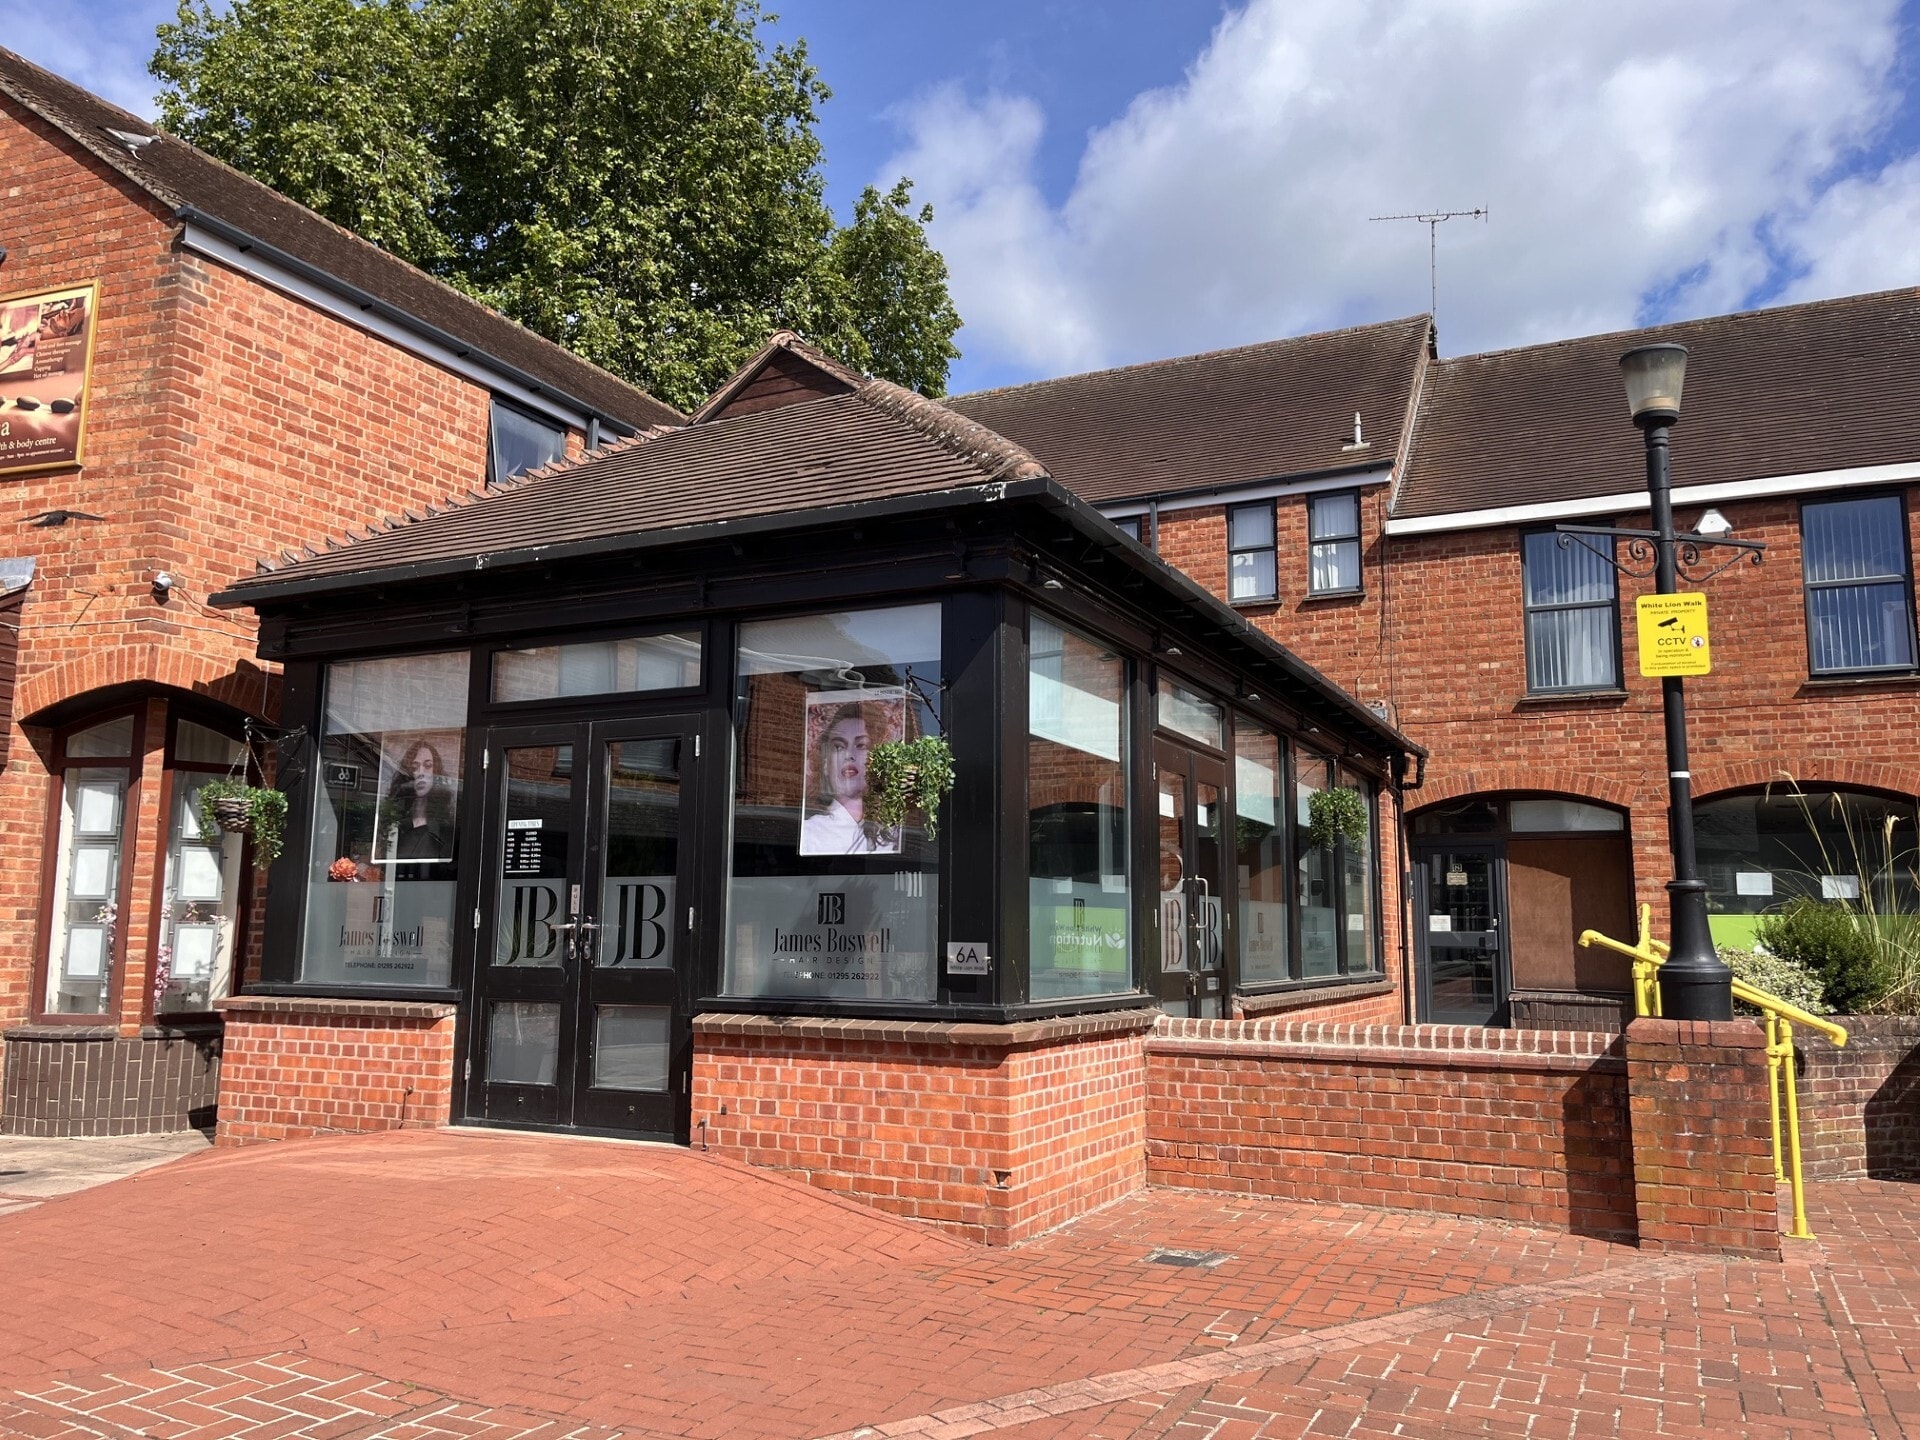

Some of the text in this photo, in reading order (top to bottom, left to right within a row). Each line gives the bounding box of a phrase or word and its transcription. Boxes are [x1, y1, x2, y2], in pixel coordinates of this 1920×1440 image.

[8, 440, 16, 450] &
[16, 438, 34, 450] body
[34, 437, 56, 446] centre
[1657, 638, 1686, 646] CCTV
[822, 895, 842, 924] JB
[339, 925, 424, 947] James swell
[506, 886, 558, 965] JB
[610, 884, 666, 966] JB
[1164, 900, 1182, 971] JB
[772, 928, 890, 954] James Boswell
[956, 946, 978, 963] 6A
